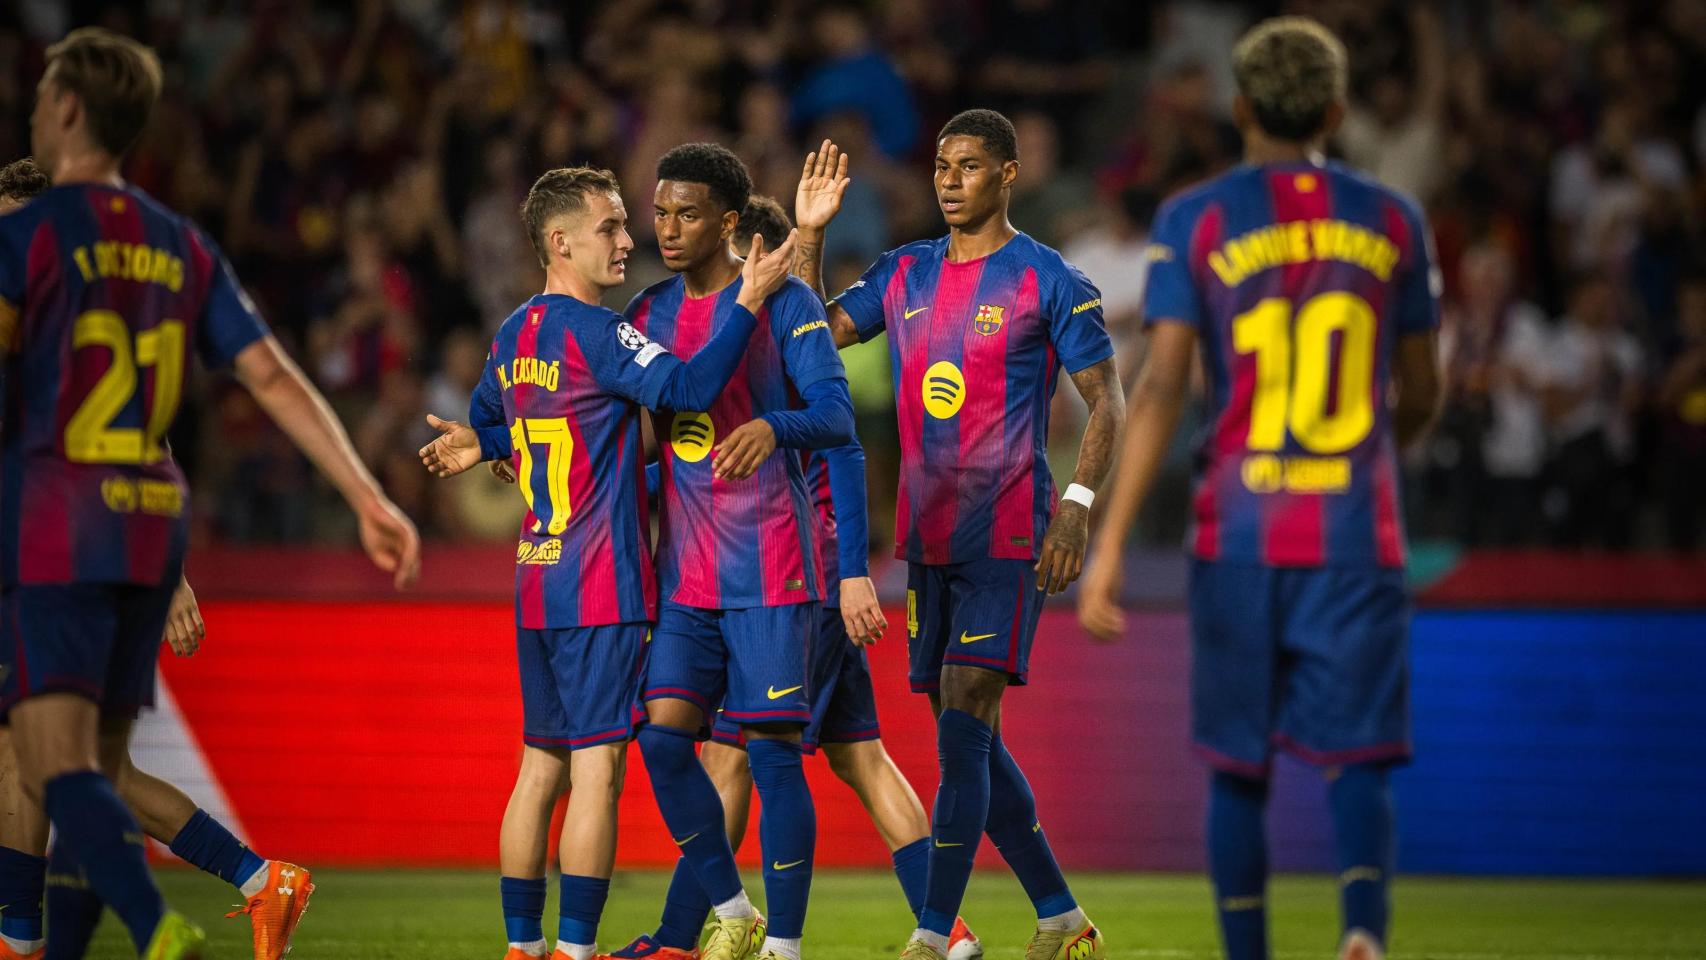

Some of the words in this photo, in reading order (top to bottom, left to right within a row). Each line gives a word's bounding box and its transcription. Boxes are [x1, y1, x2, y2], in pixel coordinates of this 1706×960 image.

[65, 311, 186, 463] 21
[513, 357, 560, 392] CASADÓ
[1232, 291, 1377, 454] 10
[509, 417, 574, 536] 17
